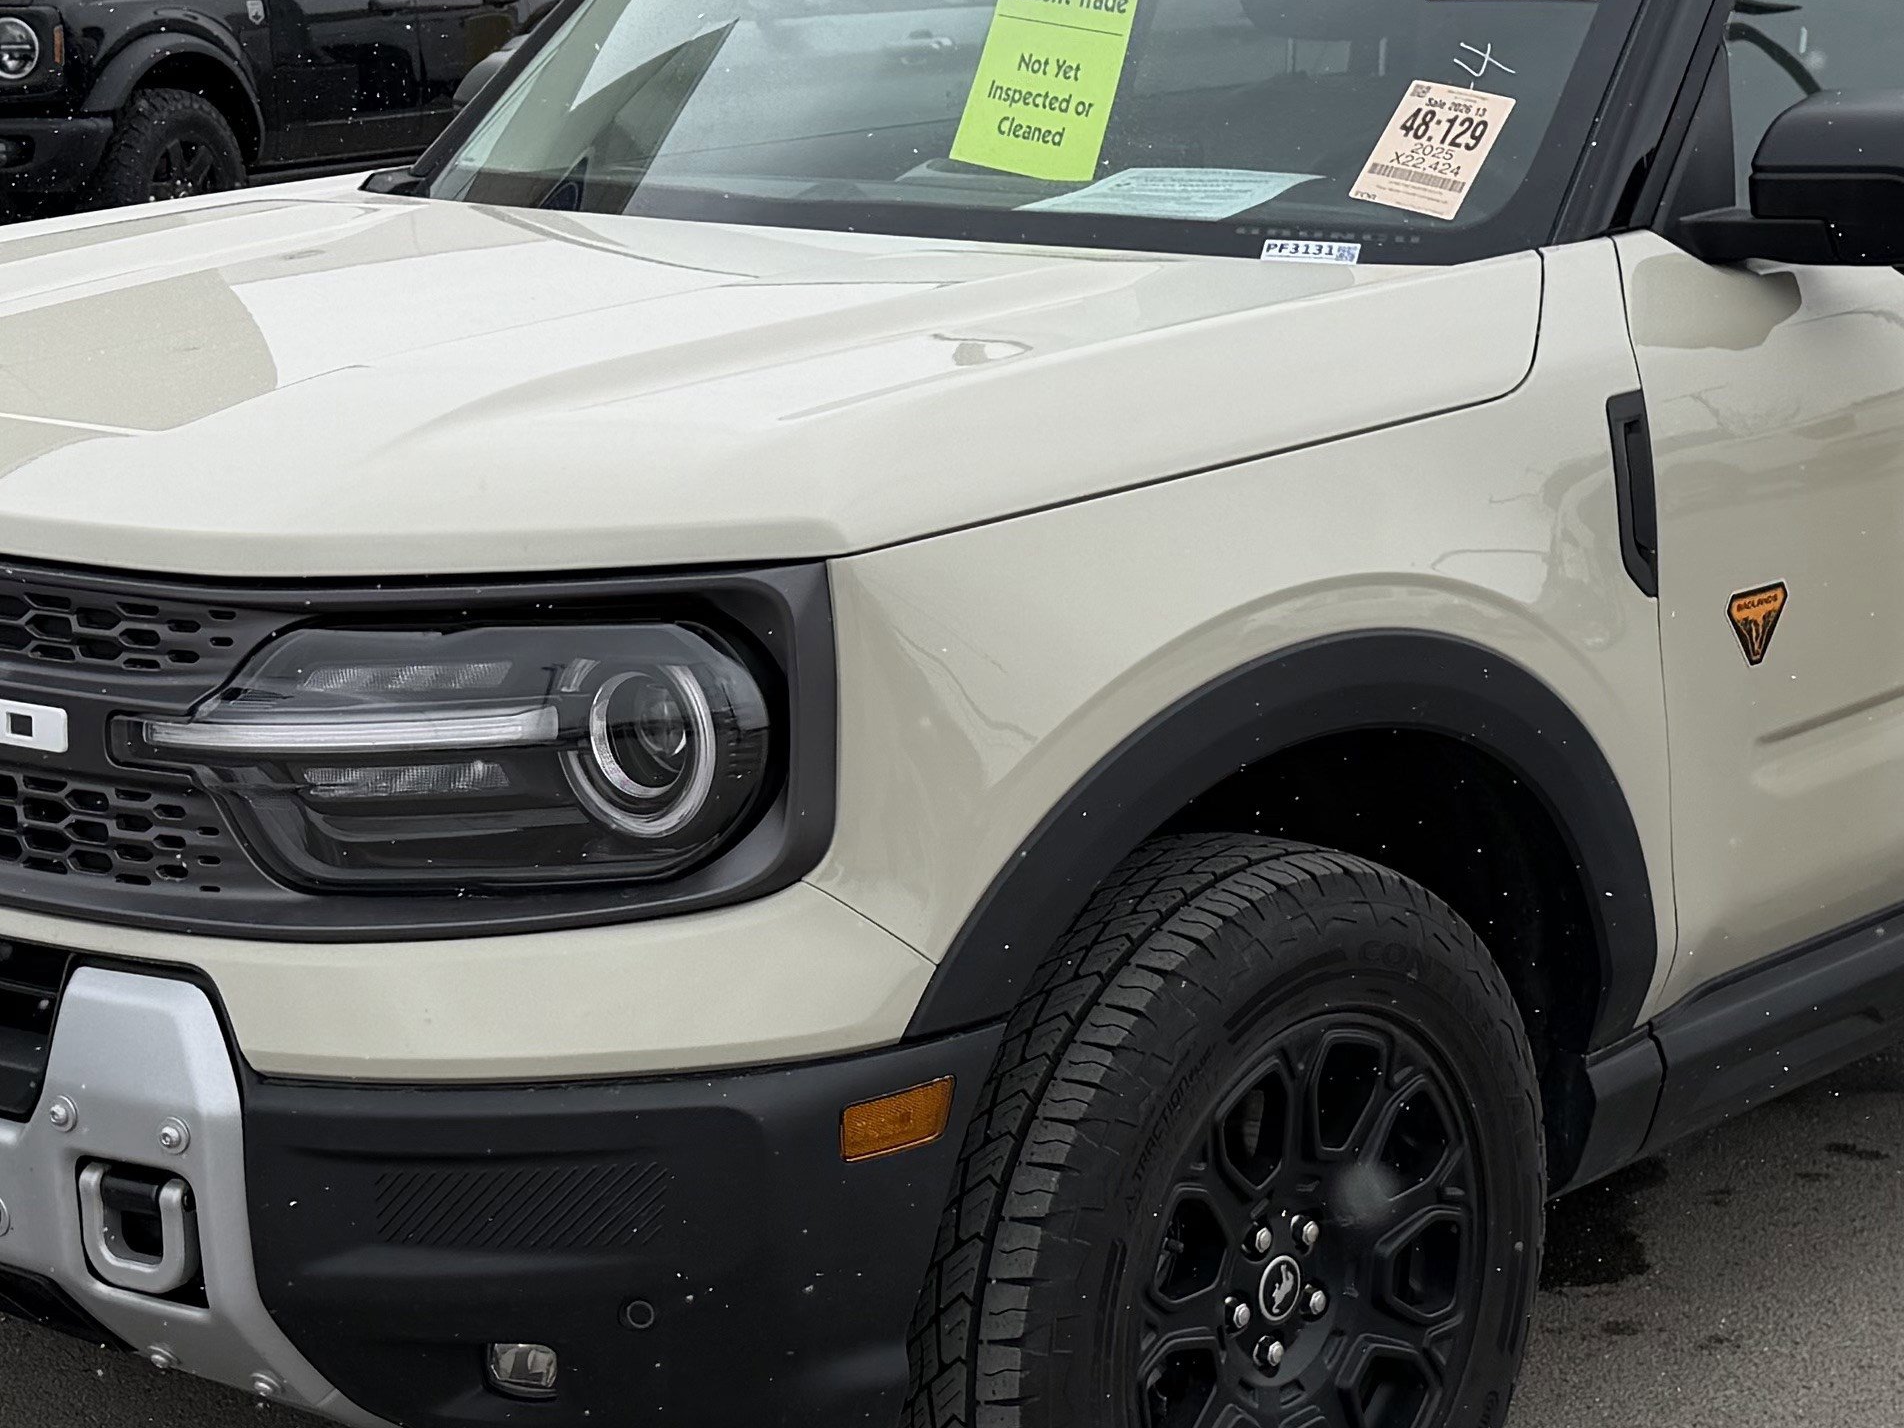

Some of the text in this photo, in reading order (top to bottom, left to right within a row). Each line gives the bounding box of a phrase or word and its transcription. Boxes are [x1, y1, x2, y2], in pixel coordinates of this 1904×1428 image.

[1017, 52, 1081, 82] Not Yet
[987, 79, 1094, 118] Inspected or
[997, 116, 1066, 147] Cleaned
[1399, 107, 1489, 151] 48:129
[1389, 151, 1462, 178] X22,424
[1410, 142, 1455, 161] 2025
[1266, 242, 1334, 256] PF3131
